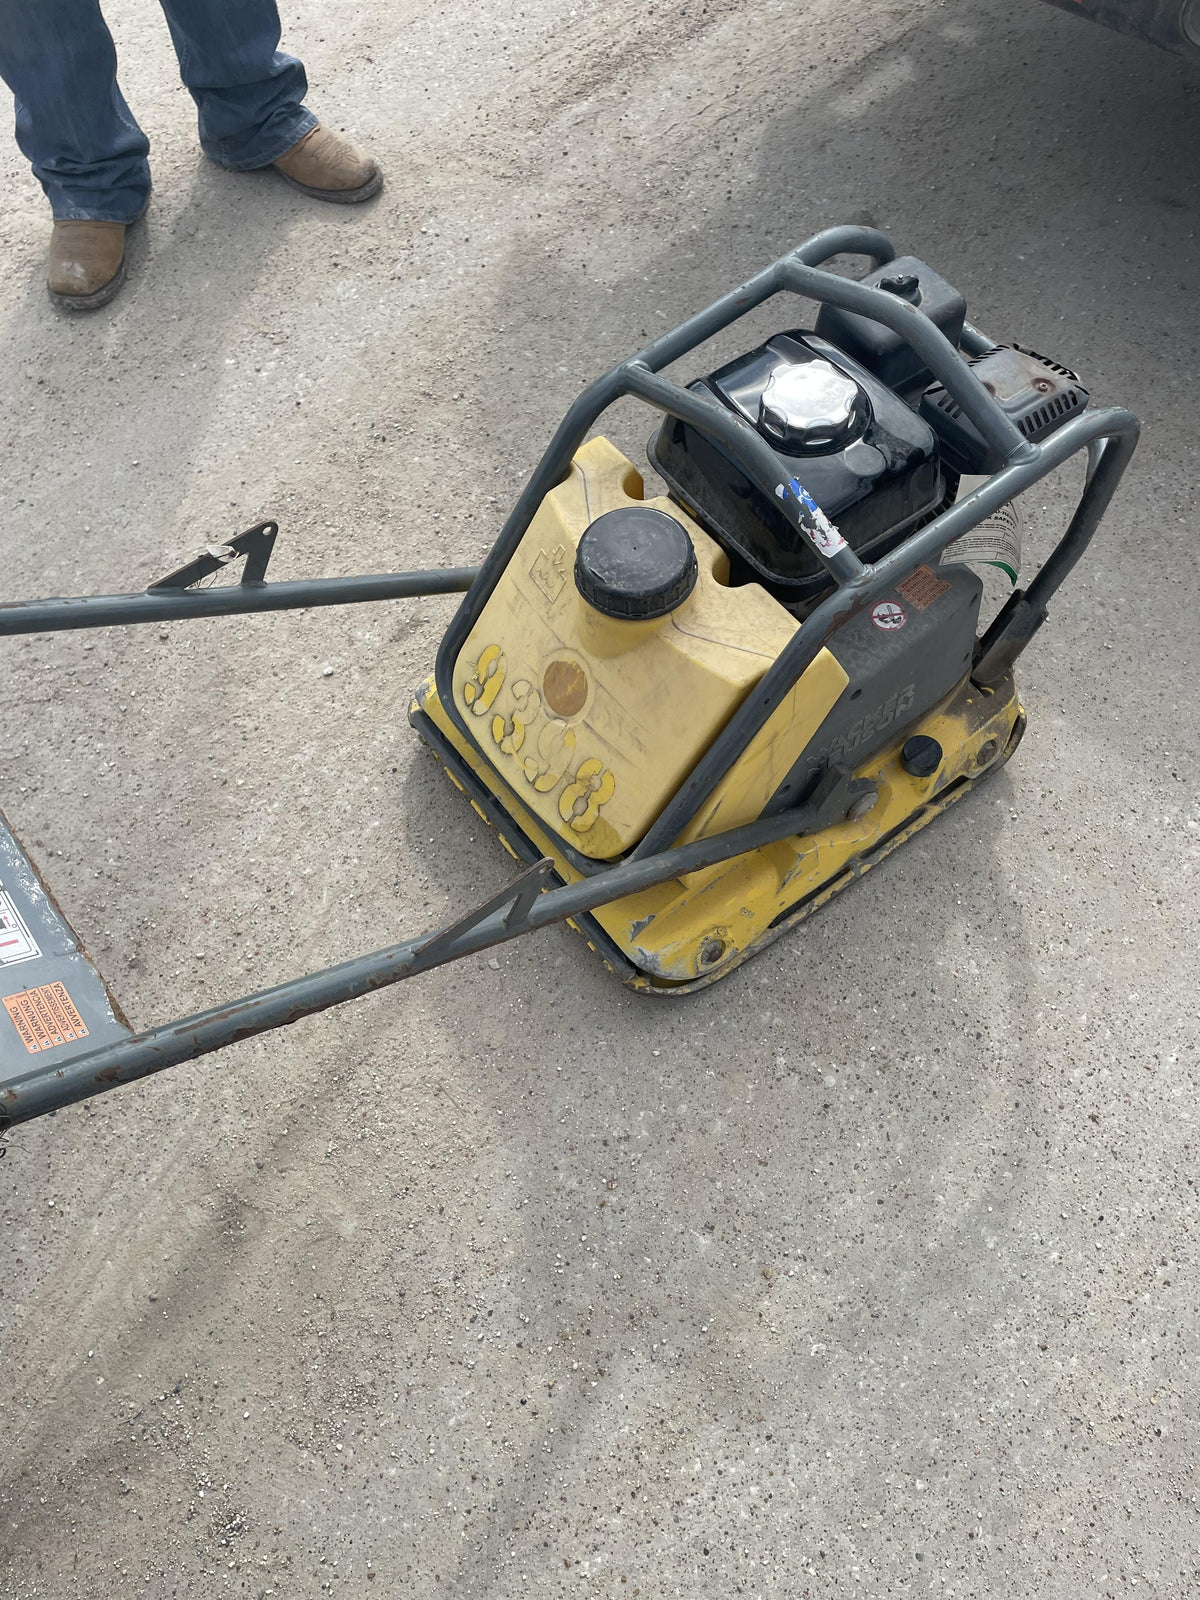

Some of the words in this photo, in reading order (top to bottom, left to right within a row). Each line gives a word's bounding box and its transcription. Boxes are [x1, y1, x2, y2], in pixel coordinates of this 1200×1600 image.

[9, 1006, 34, 1044] WARNING
[20, 999, 46, 1040] WARNUNG
[29, 989, 58, 1035] ADVERTENCIA
[40, 986, 71, 1031] ADVERTISSEMENT
[53, 982, 82, 1027] AVVERTENZA
